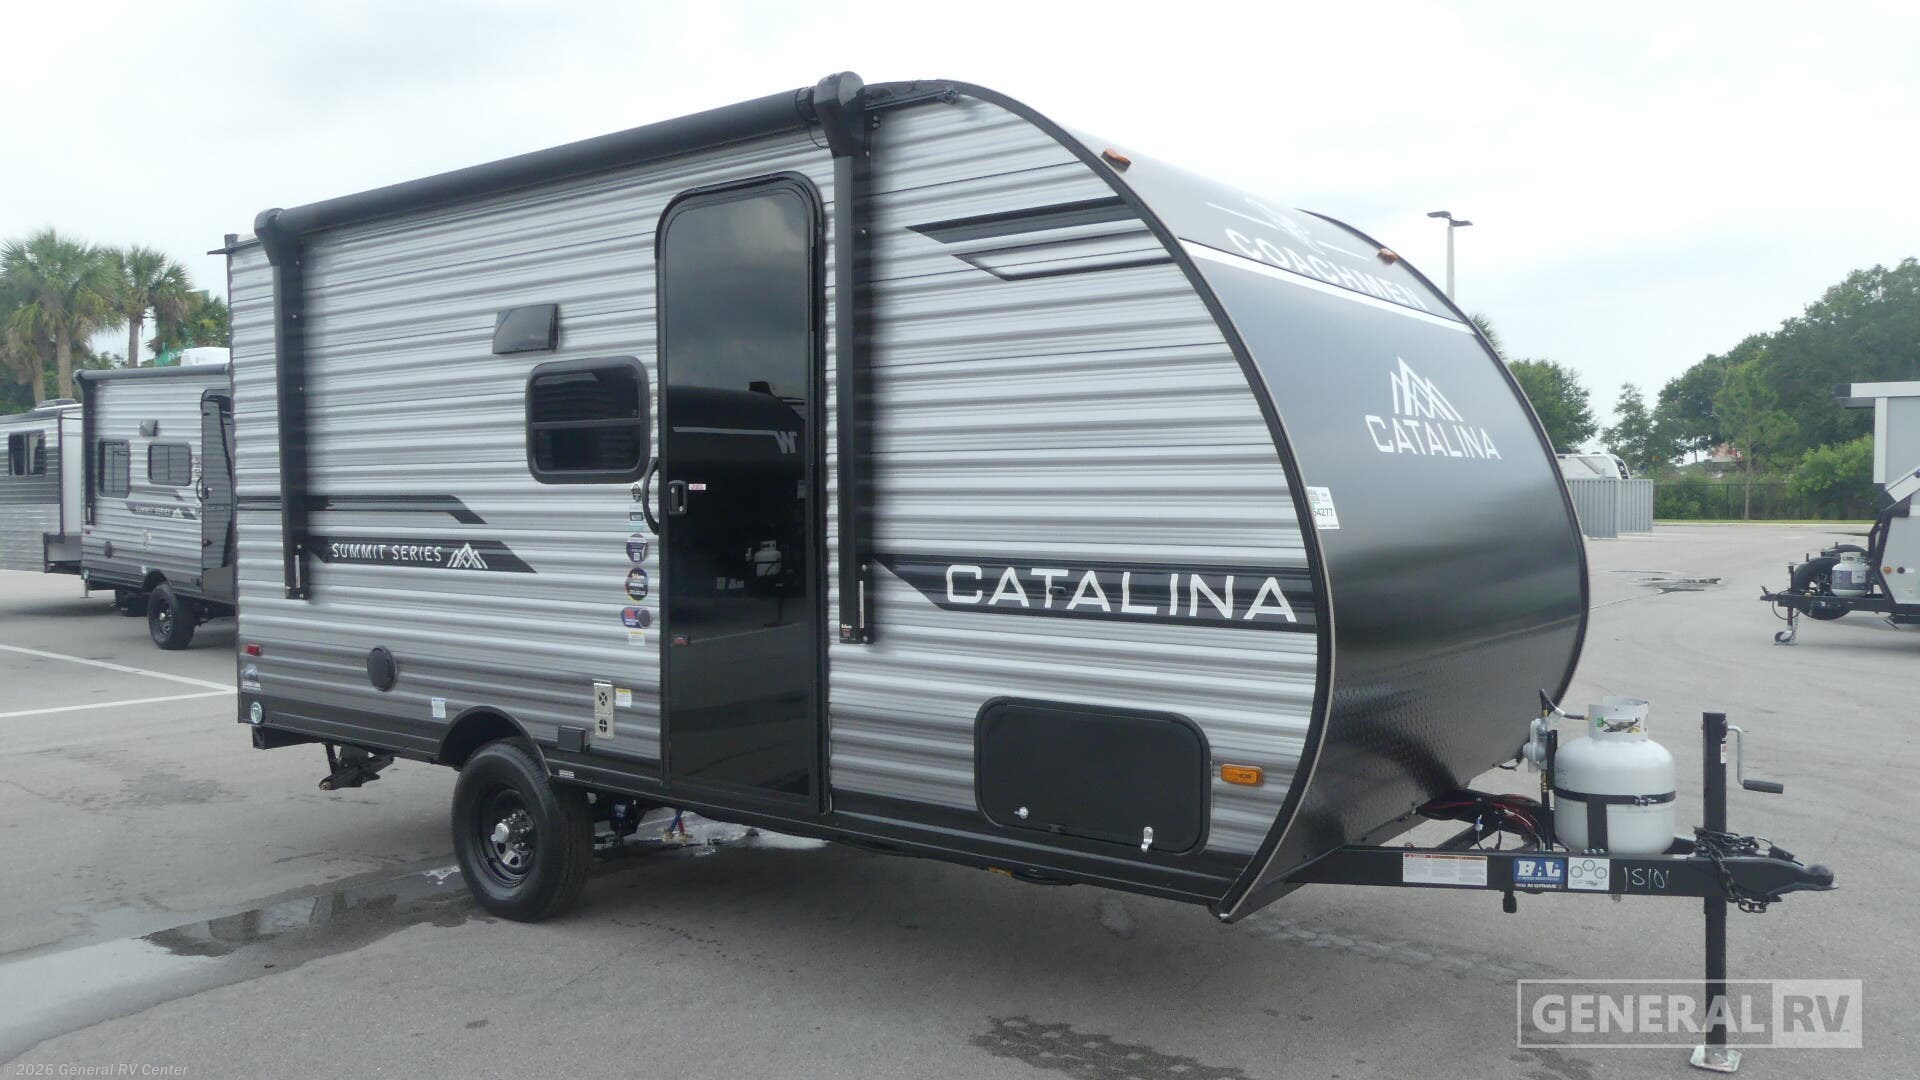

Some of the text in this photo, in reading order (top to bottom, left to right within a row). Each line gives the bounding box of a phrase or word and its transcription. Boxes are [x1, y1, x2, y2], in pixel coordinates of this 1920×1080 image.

[1225, 228, 1429, 311] COACHMEN
[1365, 414, 1502, 460] CATALINA
[331, 542, 442, 562] SUMMIT SERIES
[946, 564, 1297, 623] CATALINA
[1517, 860, 1561, 877] BAL
